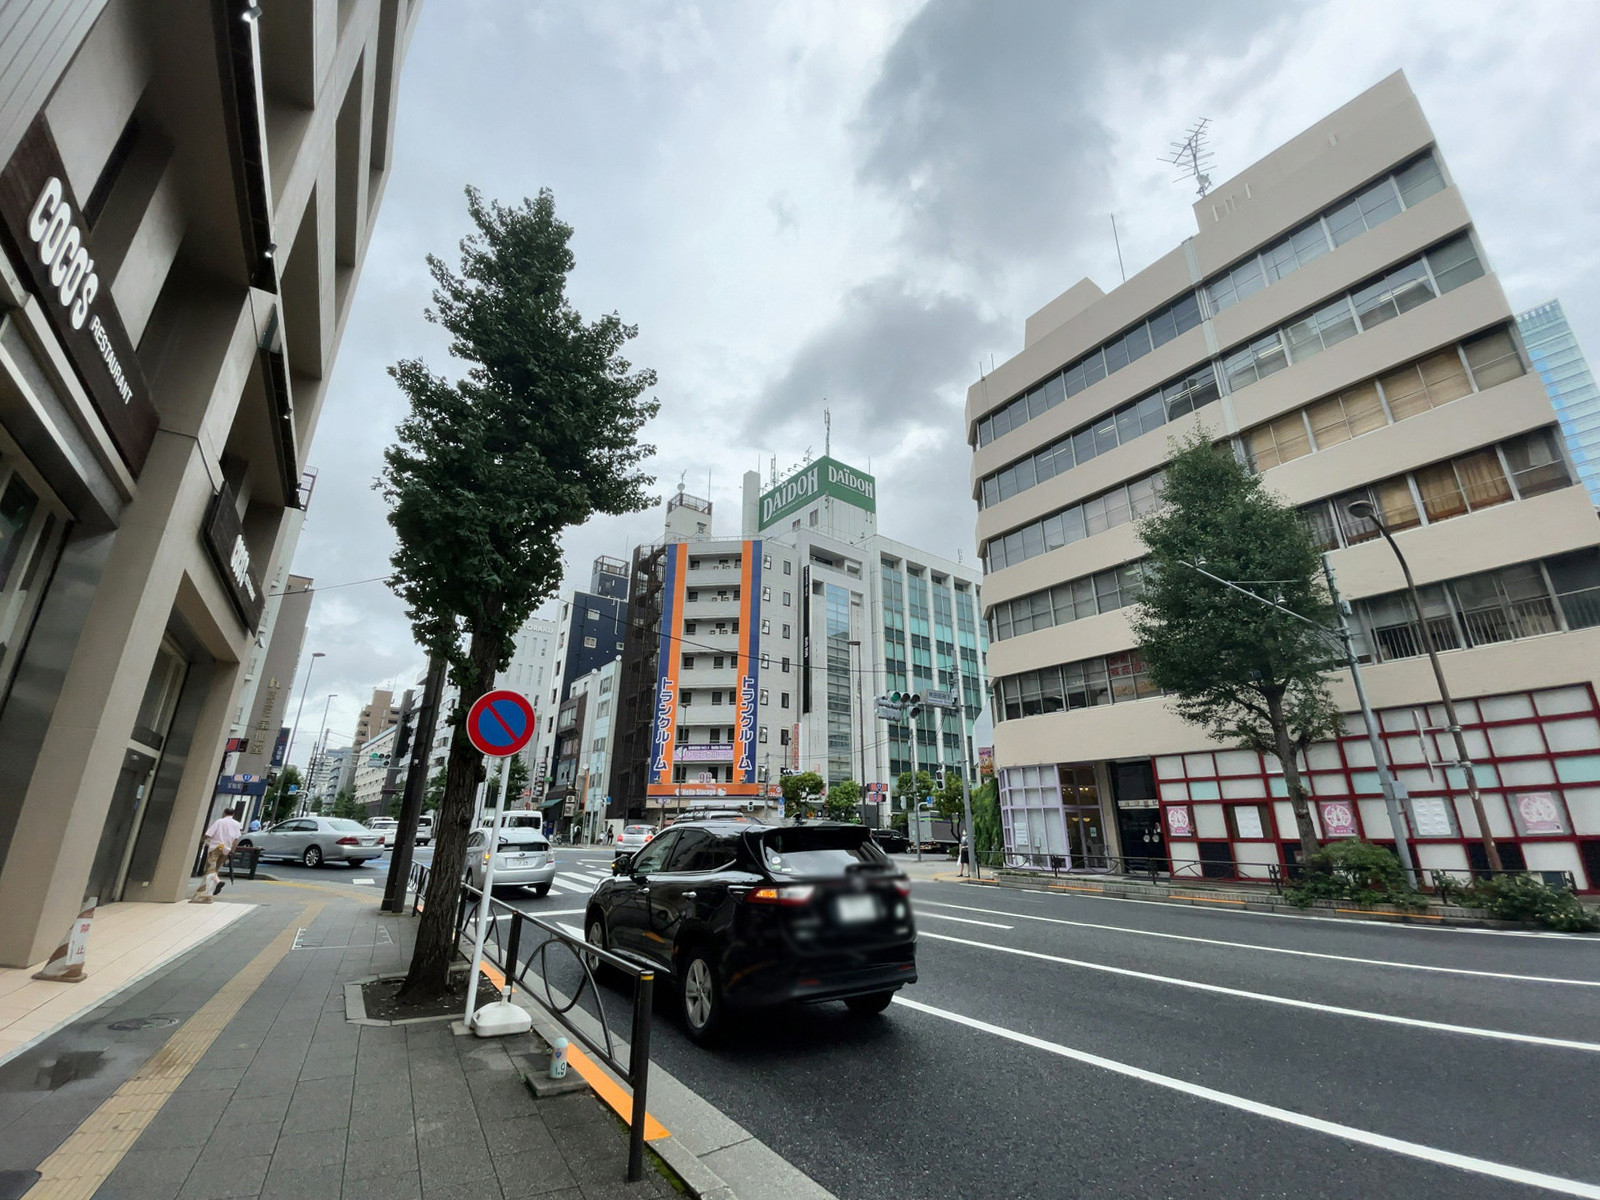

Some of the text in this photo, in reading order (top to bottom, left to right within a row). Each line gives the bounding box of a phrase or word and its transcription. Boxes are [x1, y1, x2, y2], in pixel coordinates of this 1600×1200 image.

[28, 176, 133, 405] COCO'S RESTAURANT
[654, 677, 673, 771] トランクルーム
[738, 676, 755, 770] トランクルーム
